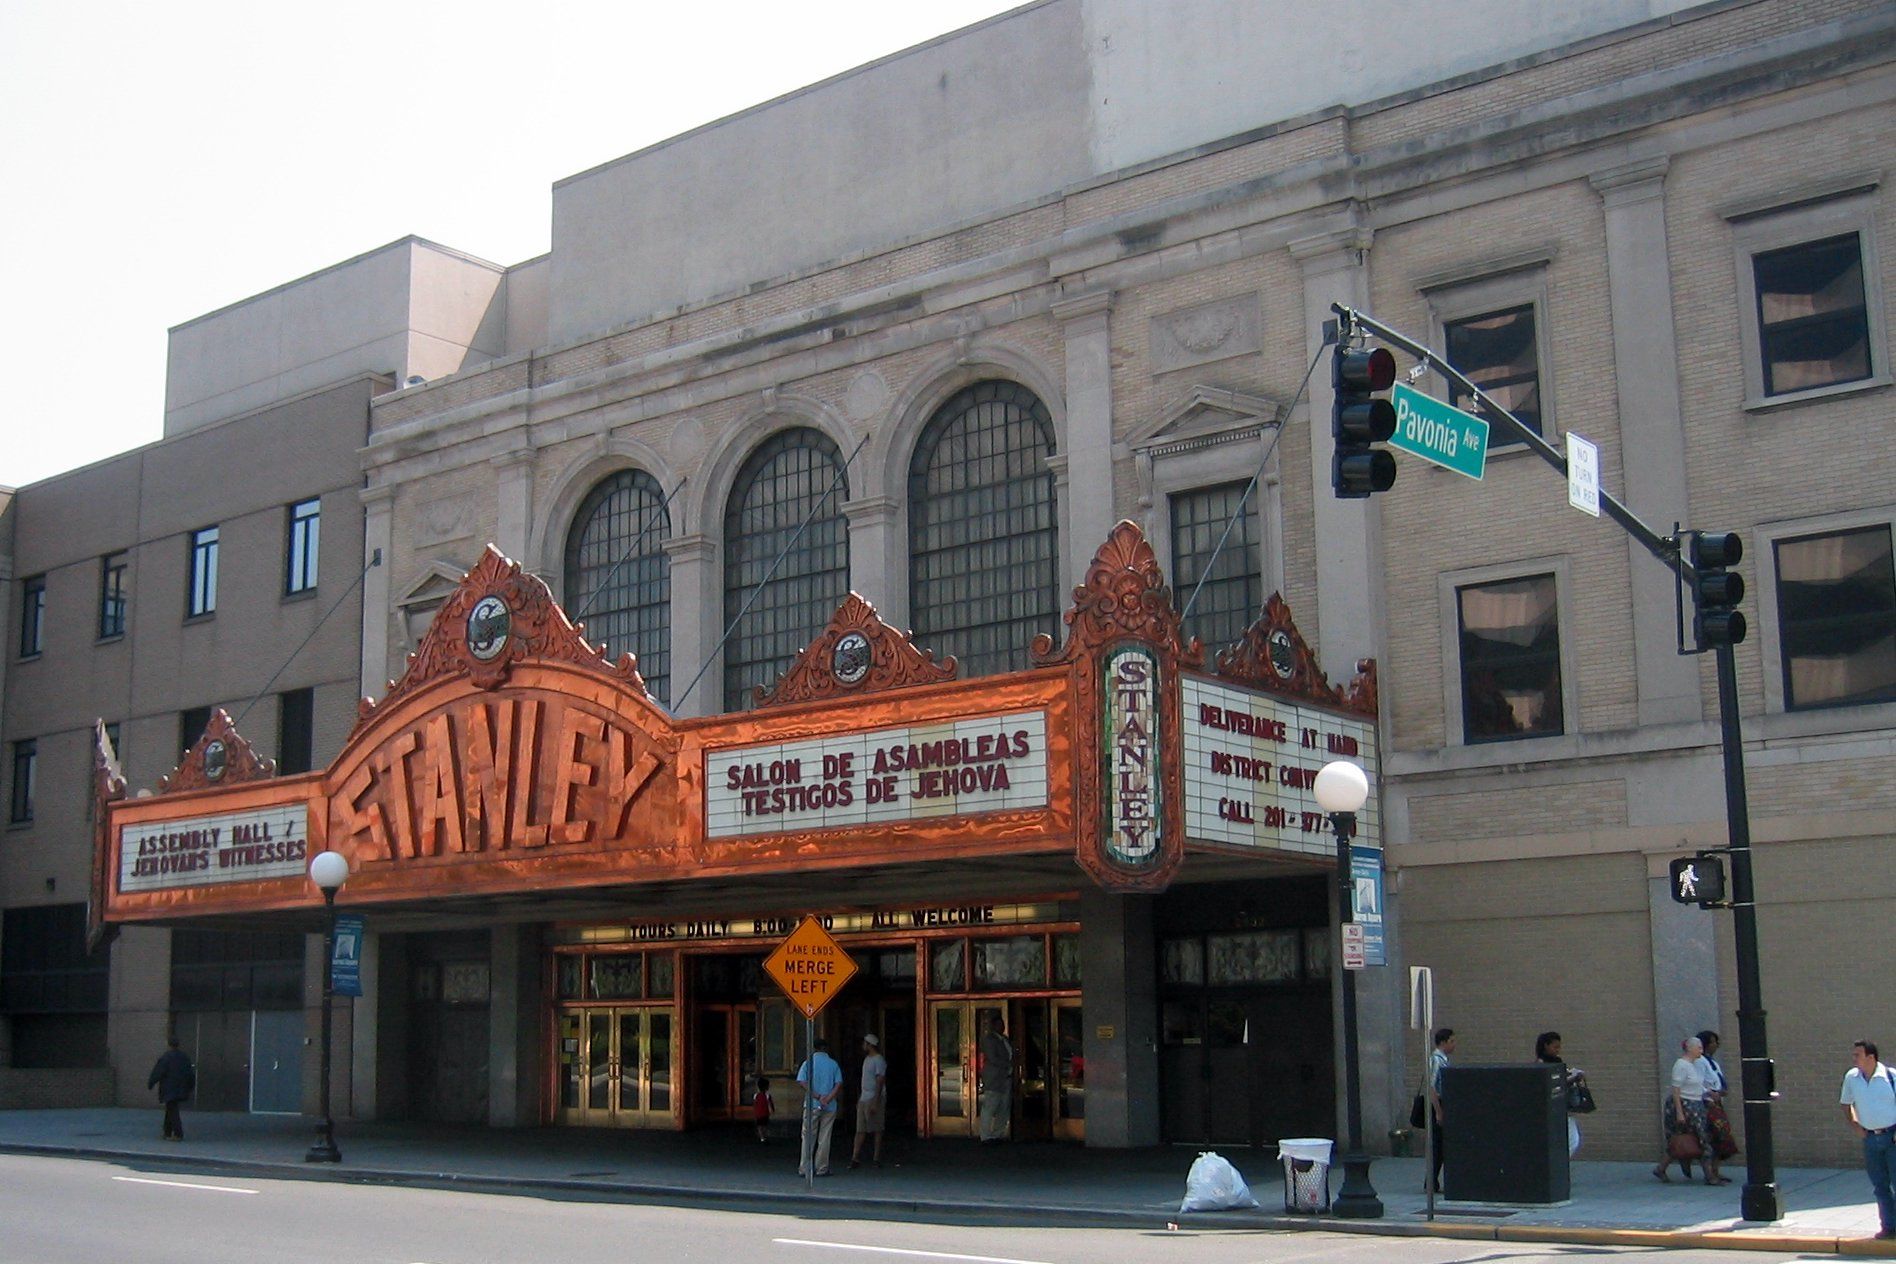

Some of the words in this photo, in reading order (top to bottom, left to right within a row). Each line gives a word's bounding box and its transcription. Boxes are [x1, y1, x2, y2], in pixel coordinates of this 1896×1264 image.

[1396, 398, 1458, 457] Pavonia
[1463, 427, 1480, 451] Ave
[1577, 446, 1588, 463] NO
[1575, 464, 1592, 484] TURN
[1200, 703, 1286, 743] DELIVERANCE
[1302, 728, 1318, 750] AT
[1327, 733, 1358, 758] HAND
[727, 758, 801, 790] SALON
[823, 753, 855, 780] DE
[872, 730, 1030, 775] ASAMBLEAS
[1118, 661, 1150, 848] STANLEY
[1211, 751, 1273, 783] DISTRICT
[331, 700, 664, 861] STANLEY
[741, 780, 854, 816] TESTIGOS
[865, 776, 899, 804] DE
[910, 764, 1011, 799] JEHOVA
[1218, 797, 1254, 825] CALL
[138, 828, 221, 856] ASSEMBLY
[232, 822, 273, 846] HALL
[219, 839, 307, 868] WITNESSES
[630, 921, 676, 941] TOURS
[686, 919, 730, 939] DAILY
[872, 911, 899, 929] ALL
[912, 905, 994, 927] WELCOME
[786, 945, 807, 955] LANE
[812, 945, 834, 956] ENDS
[785, 960, 835, 975] MERGE
[791, 980, 828, 994] LEFT
